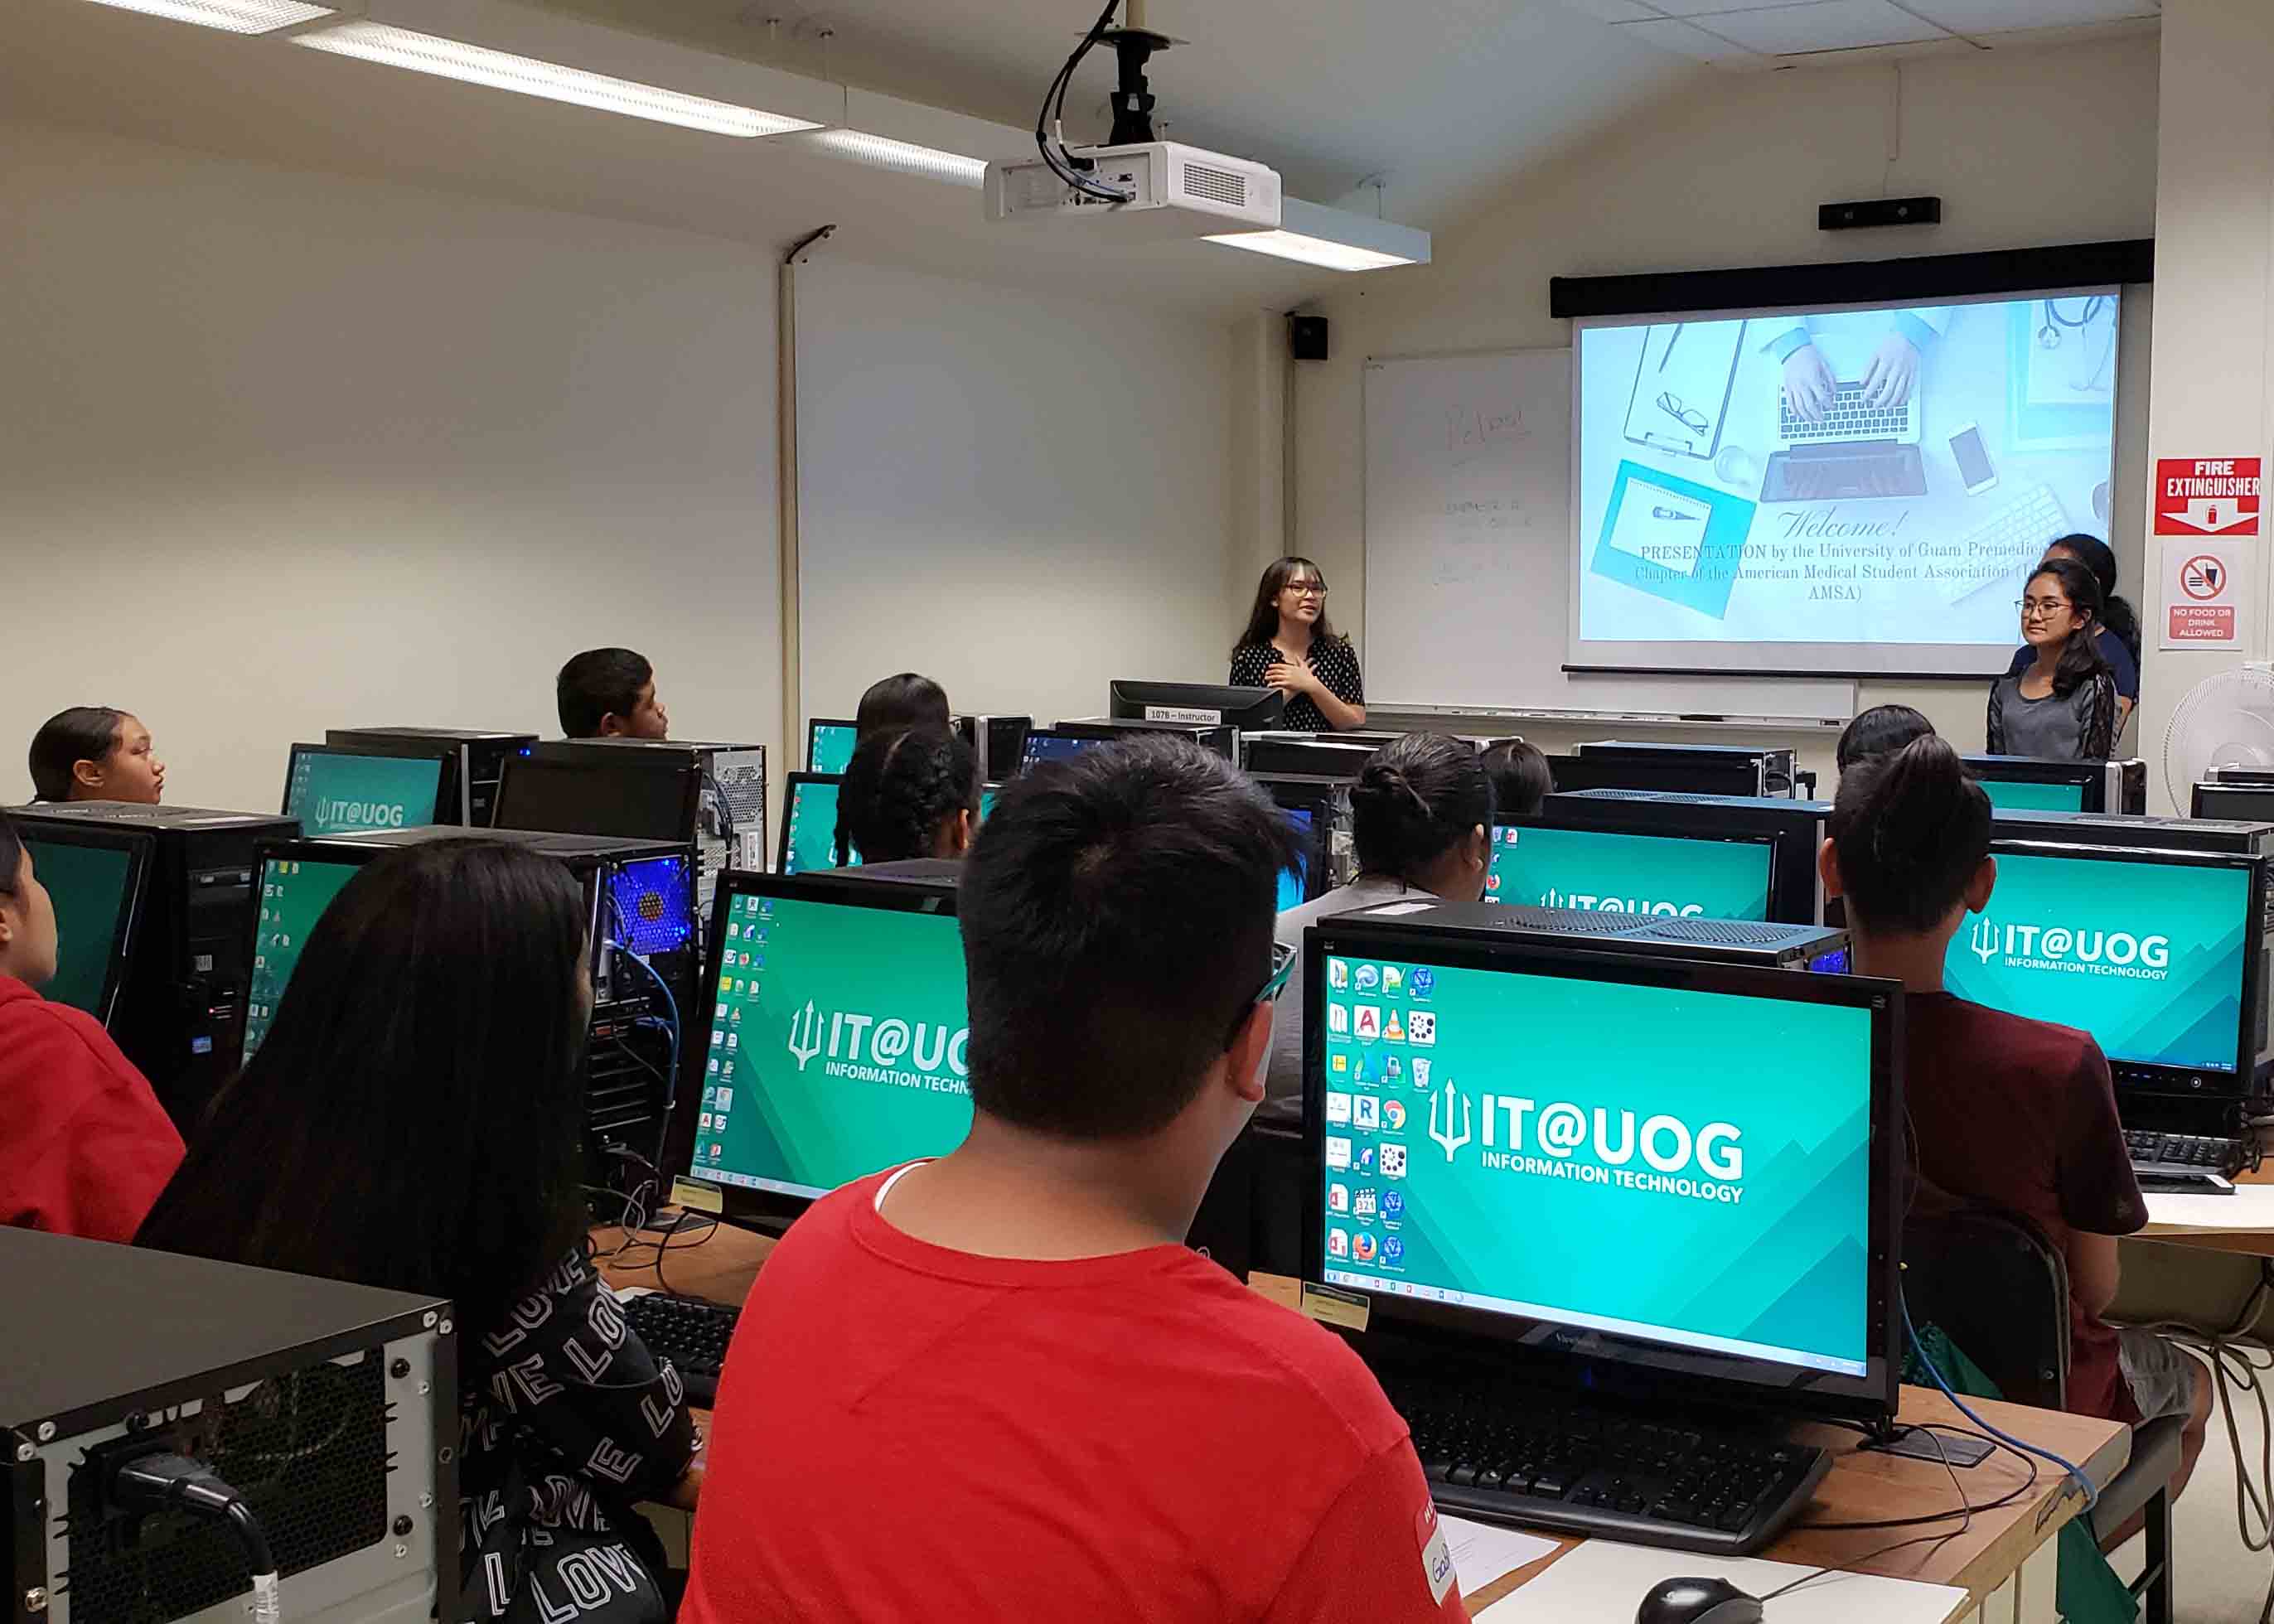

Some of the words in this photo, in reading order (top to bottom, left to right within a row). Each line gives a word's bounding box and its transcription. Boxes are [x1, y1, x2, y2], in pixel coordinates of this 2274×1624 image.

[2194, 461, 2235, 476] FIRE
[2167, 477, 2261, 497] EXTINGUISHER
[1778, 506, 1909, 538] Welcome!
[1641, 544, 1767, 560] PRESENTATION
[1772, 544, 1784, 562] by
[1793, 544, 1815, 558] the
[1820, 542, 1893, 561] University
[1899, 542, 1914, 558] of
[1918, 541, 1962, 557] Guam
[1635, 565, 1691, 583] Chapter
[1692, 564, 1707, 580] of
[1708, 564, 1730, 580] the
[1736, 564, 1799, 579] American
[1804, 563, 1856, 579] Medical
[1862, 563, 1918, 578] Student
[1924, 563, 2010, 578] Association
[1808, 585, 1863, 603] AMSA)
[2174, 609, 2187, 617] NO
[2189, 609, 2215, 617] FOOD
[2218, 609, 2231, 617] OR
[1178, 712, 1215, 722] Instructor
[331, 801, 404, 827] IT@UOG
[2005, 924, 2169, 968] IT@UOG
[2004, 956, 2086, 974] INFORMATION
[2088, 964, 2168, 981] TECHNOLOGY
[1360, 1009, 1376, 1033] A
[825, 1061, 922, 1089] INFORMATION
[1360, 1099, 1373, 1119] R
[1482, 1093, 1744, 1182] IT@UOG
[1482, 1151, 1609, 1185] INFORMATION
[1613, 1168, 1744, 1205] TECHNOLOGY
